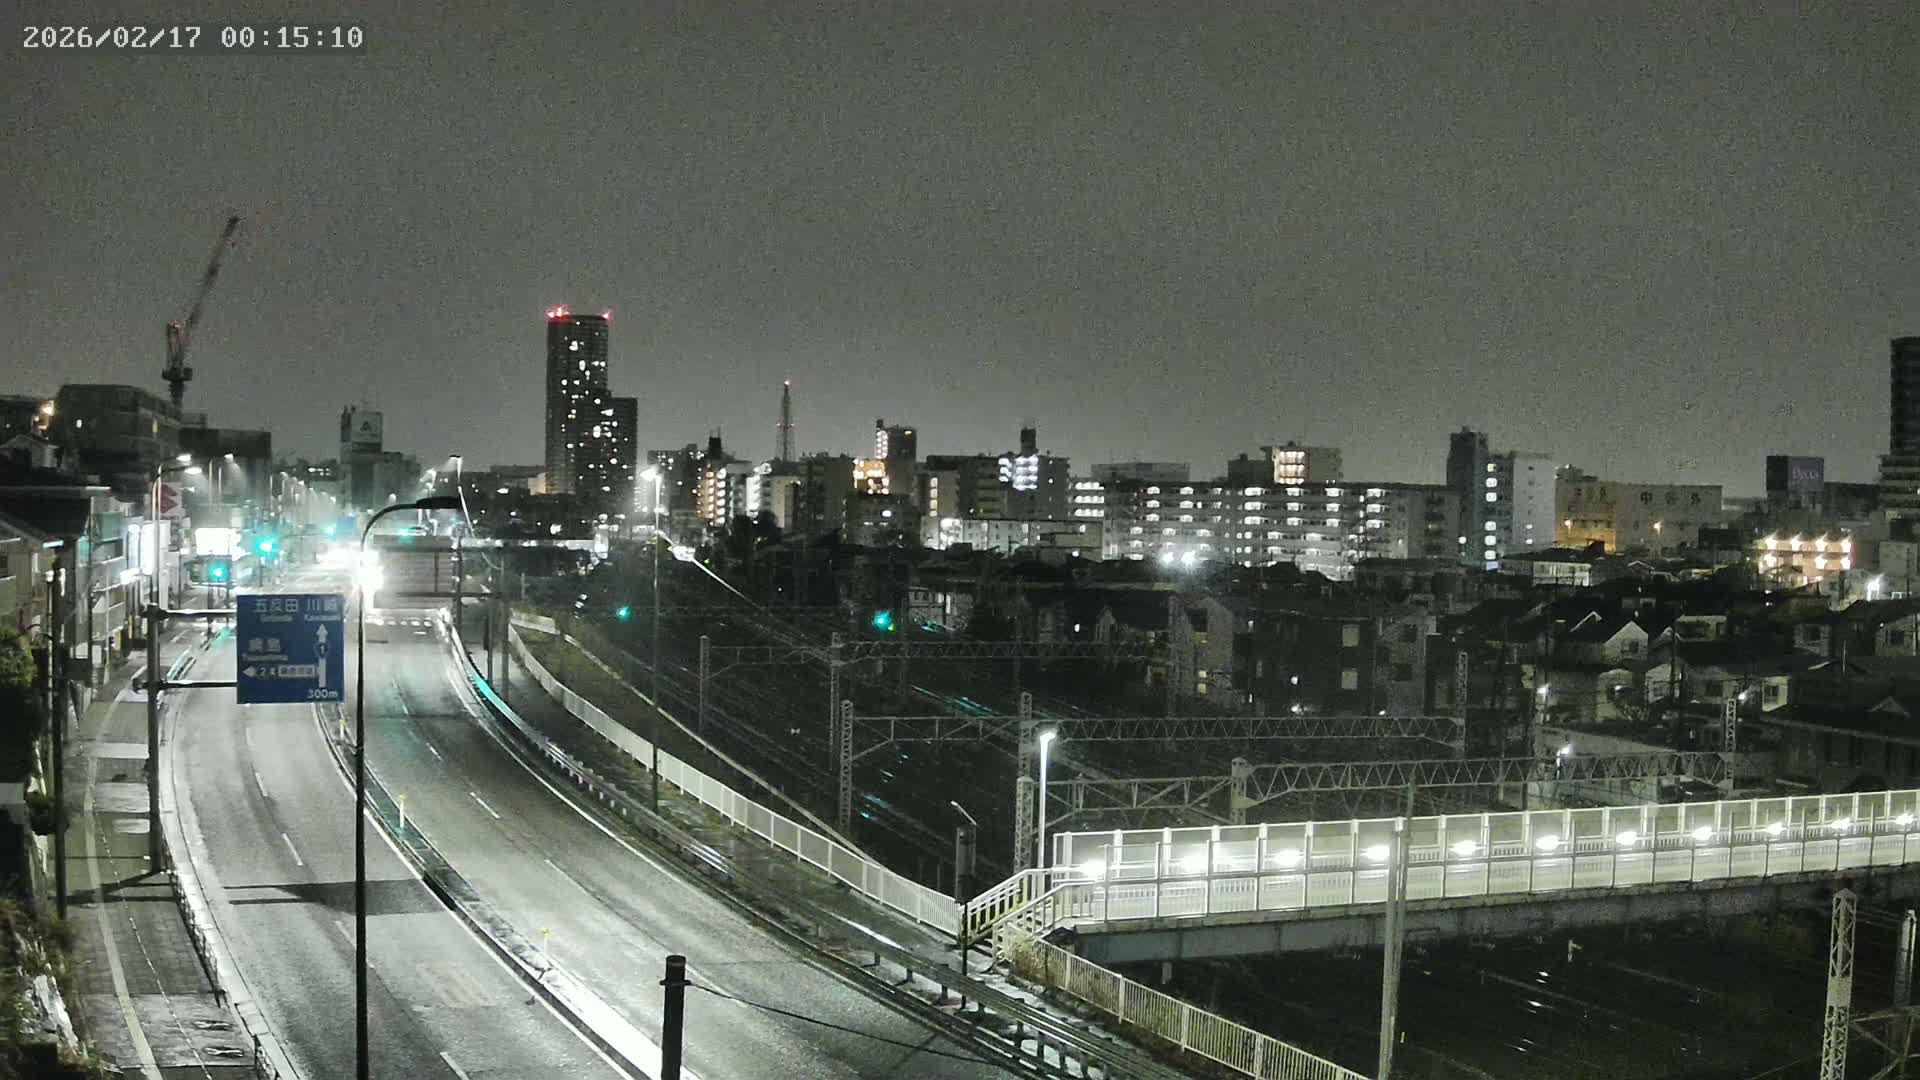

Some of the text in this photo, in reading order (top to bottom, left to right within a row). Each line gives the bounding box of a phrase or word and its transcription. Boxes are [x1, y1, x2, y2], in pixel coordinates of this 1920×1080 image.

[255, 598, 299, 612] 五反田
[306, 689, 339, 699] 300m
